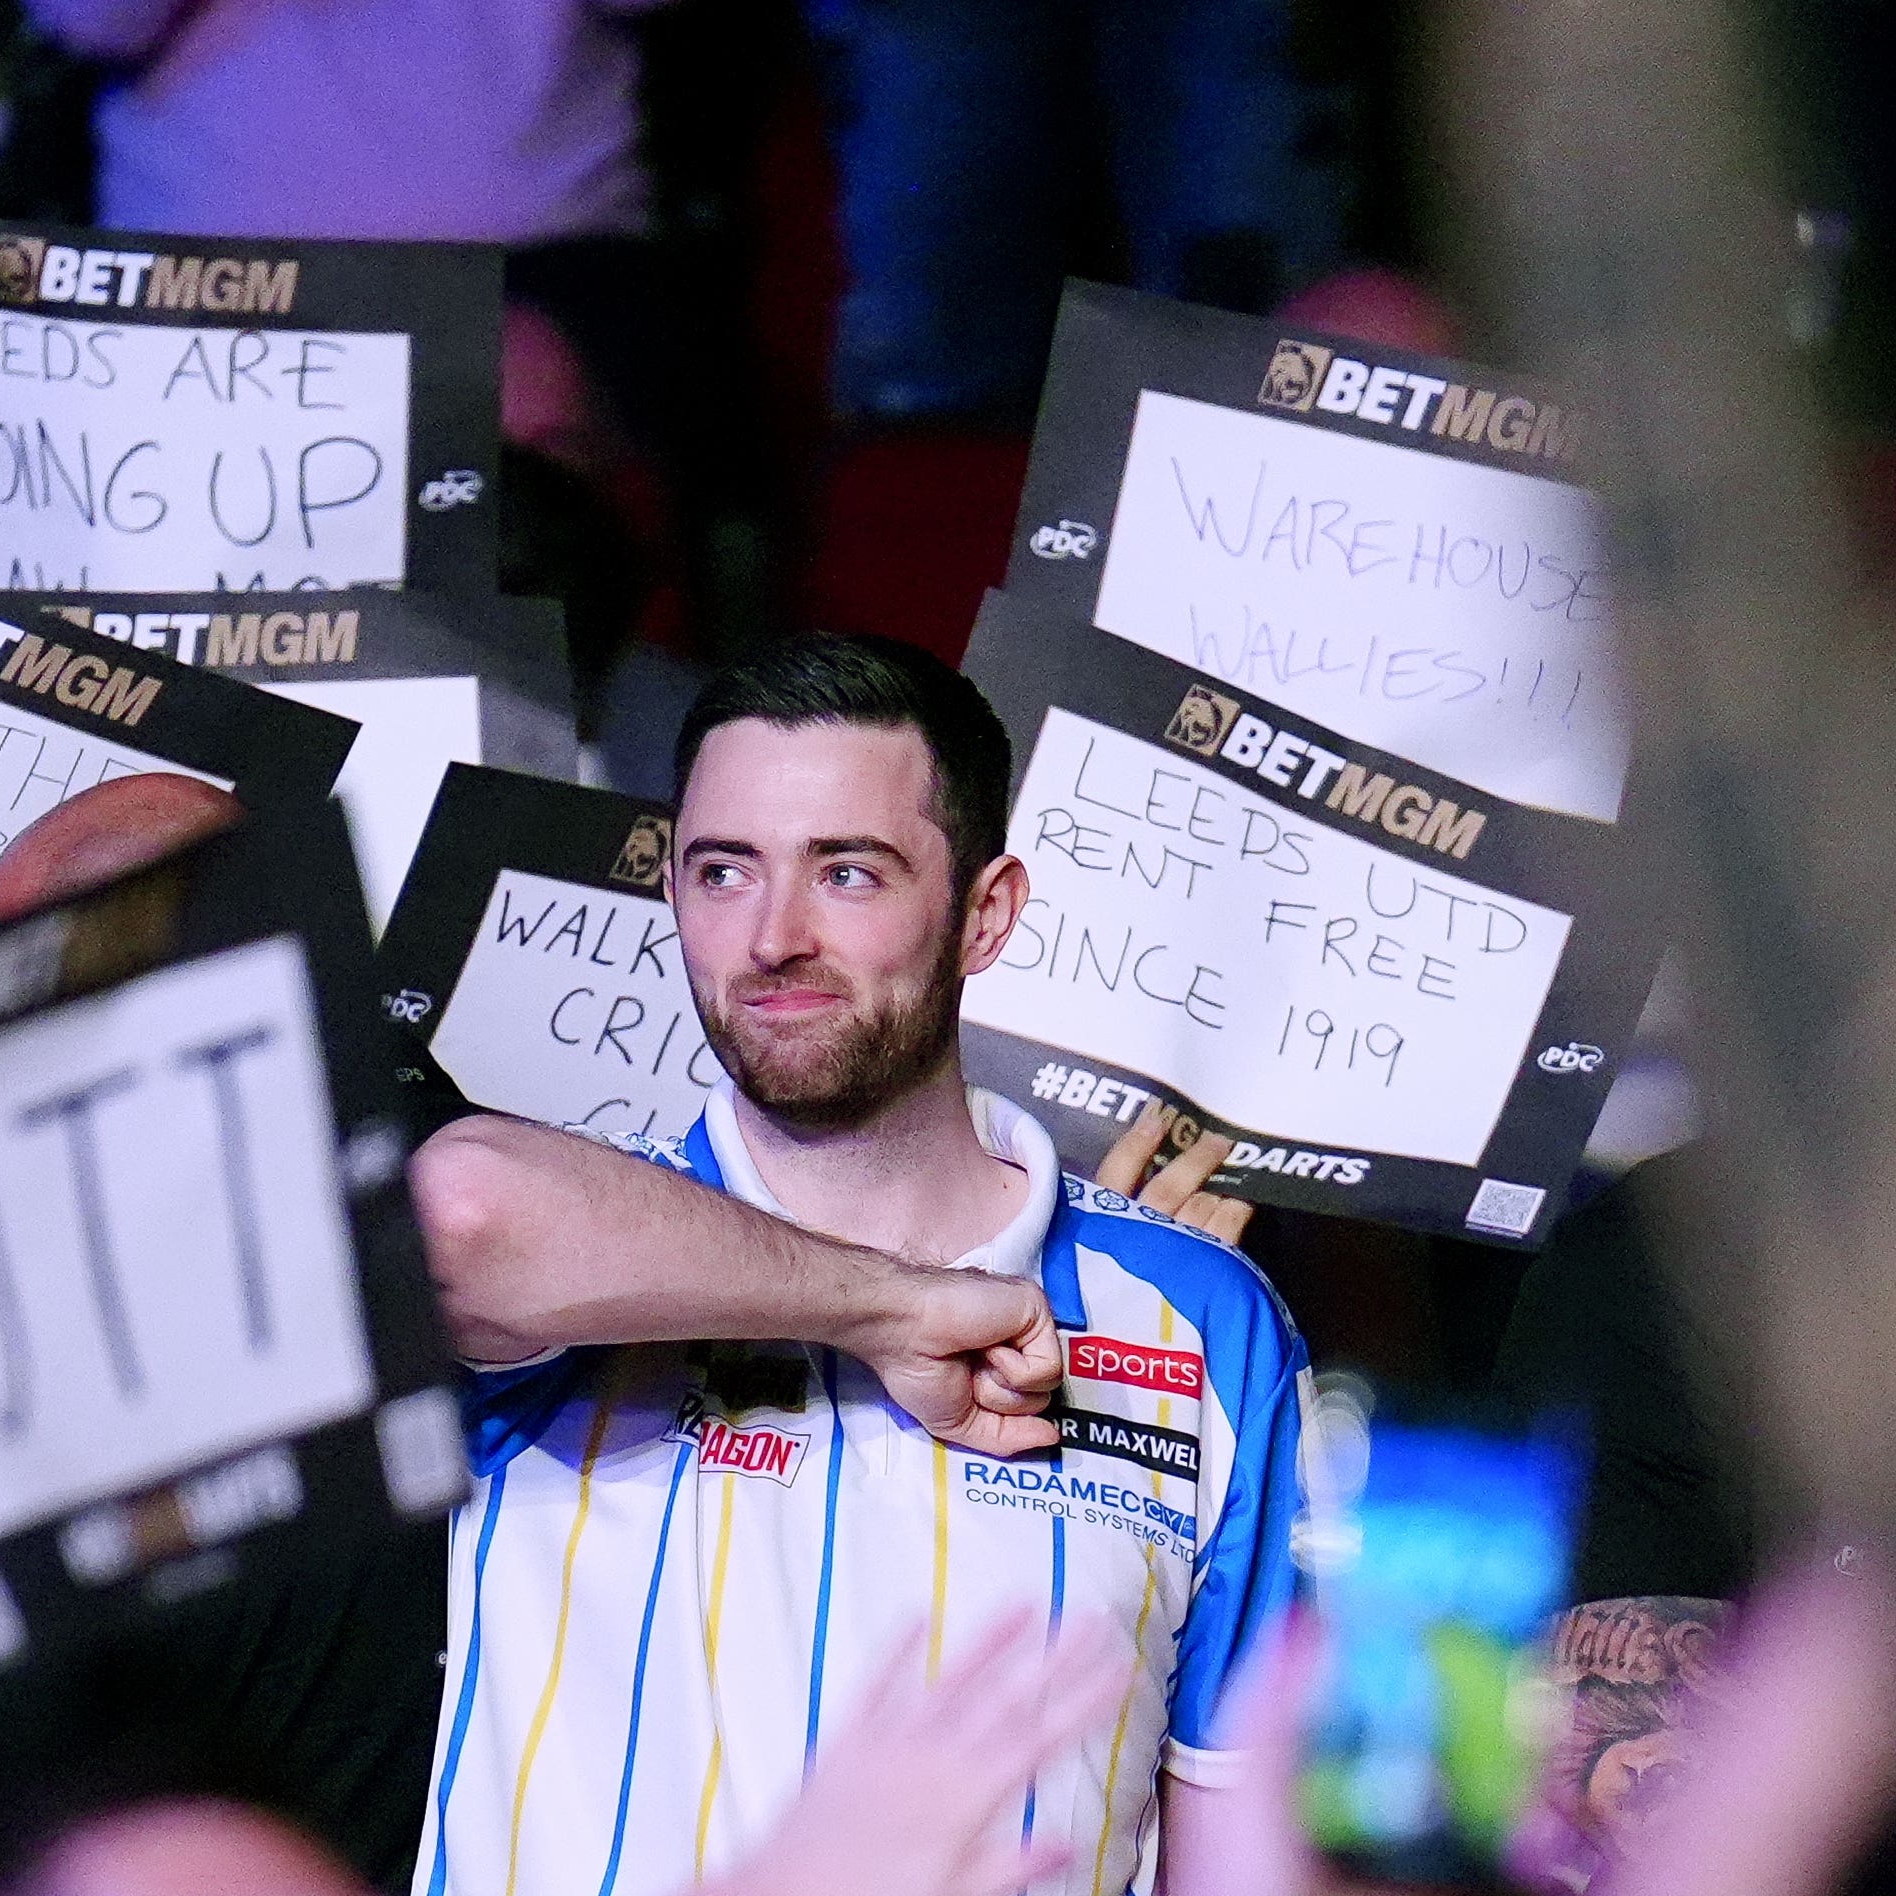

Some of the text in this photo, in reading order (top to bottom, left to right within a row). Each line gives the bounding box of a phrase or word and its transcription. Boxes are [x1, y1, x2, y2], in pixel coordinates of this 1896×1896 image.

[39, 245, 299, 314] BETMGM
[164, 330, 346, 410] ARE
[210, 436, 382, 549] UP
[1171, 456, 1605, 621] WAREHOUSE
[1189, 604, 1582, 729] WALLIES!!!
[1221, 712, 1487, 860] BETMGM
[1074, 737, 1527, 954] LEEDS UTD
[498, 889, 678, 978] WALK
[1036, 808, 1458, 1001] RENT FREE
[999, 899, 1405, 1087] SINCE 1919
[1543, 1045, 1601, 1073] PDC
[1077, 1344, 1199, 1387] sports
[966, 1488, 1077, 1519] CONTROL
[1084, 1508, 1168, 1547] SYSTEMS
